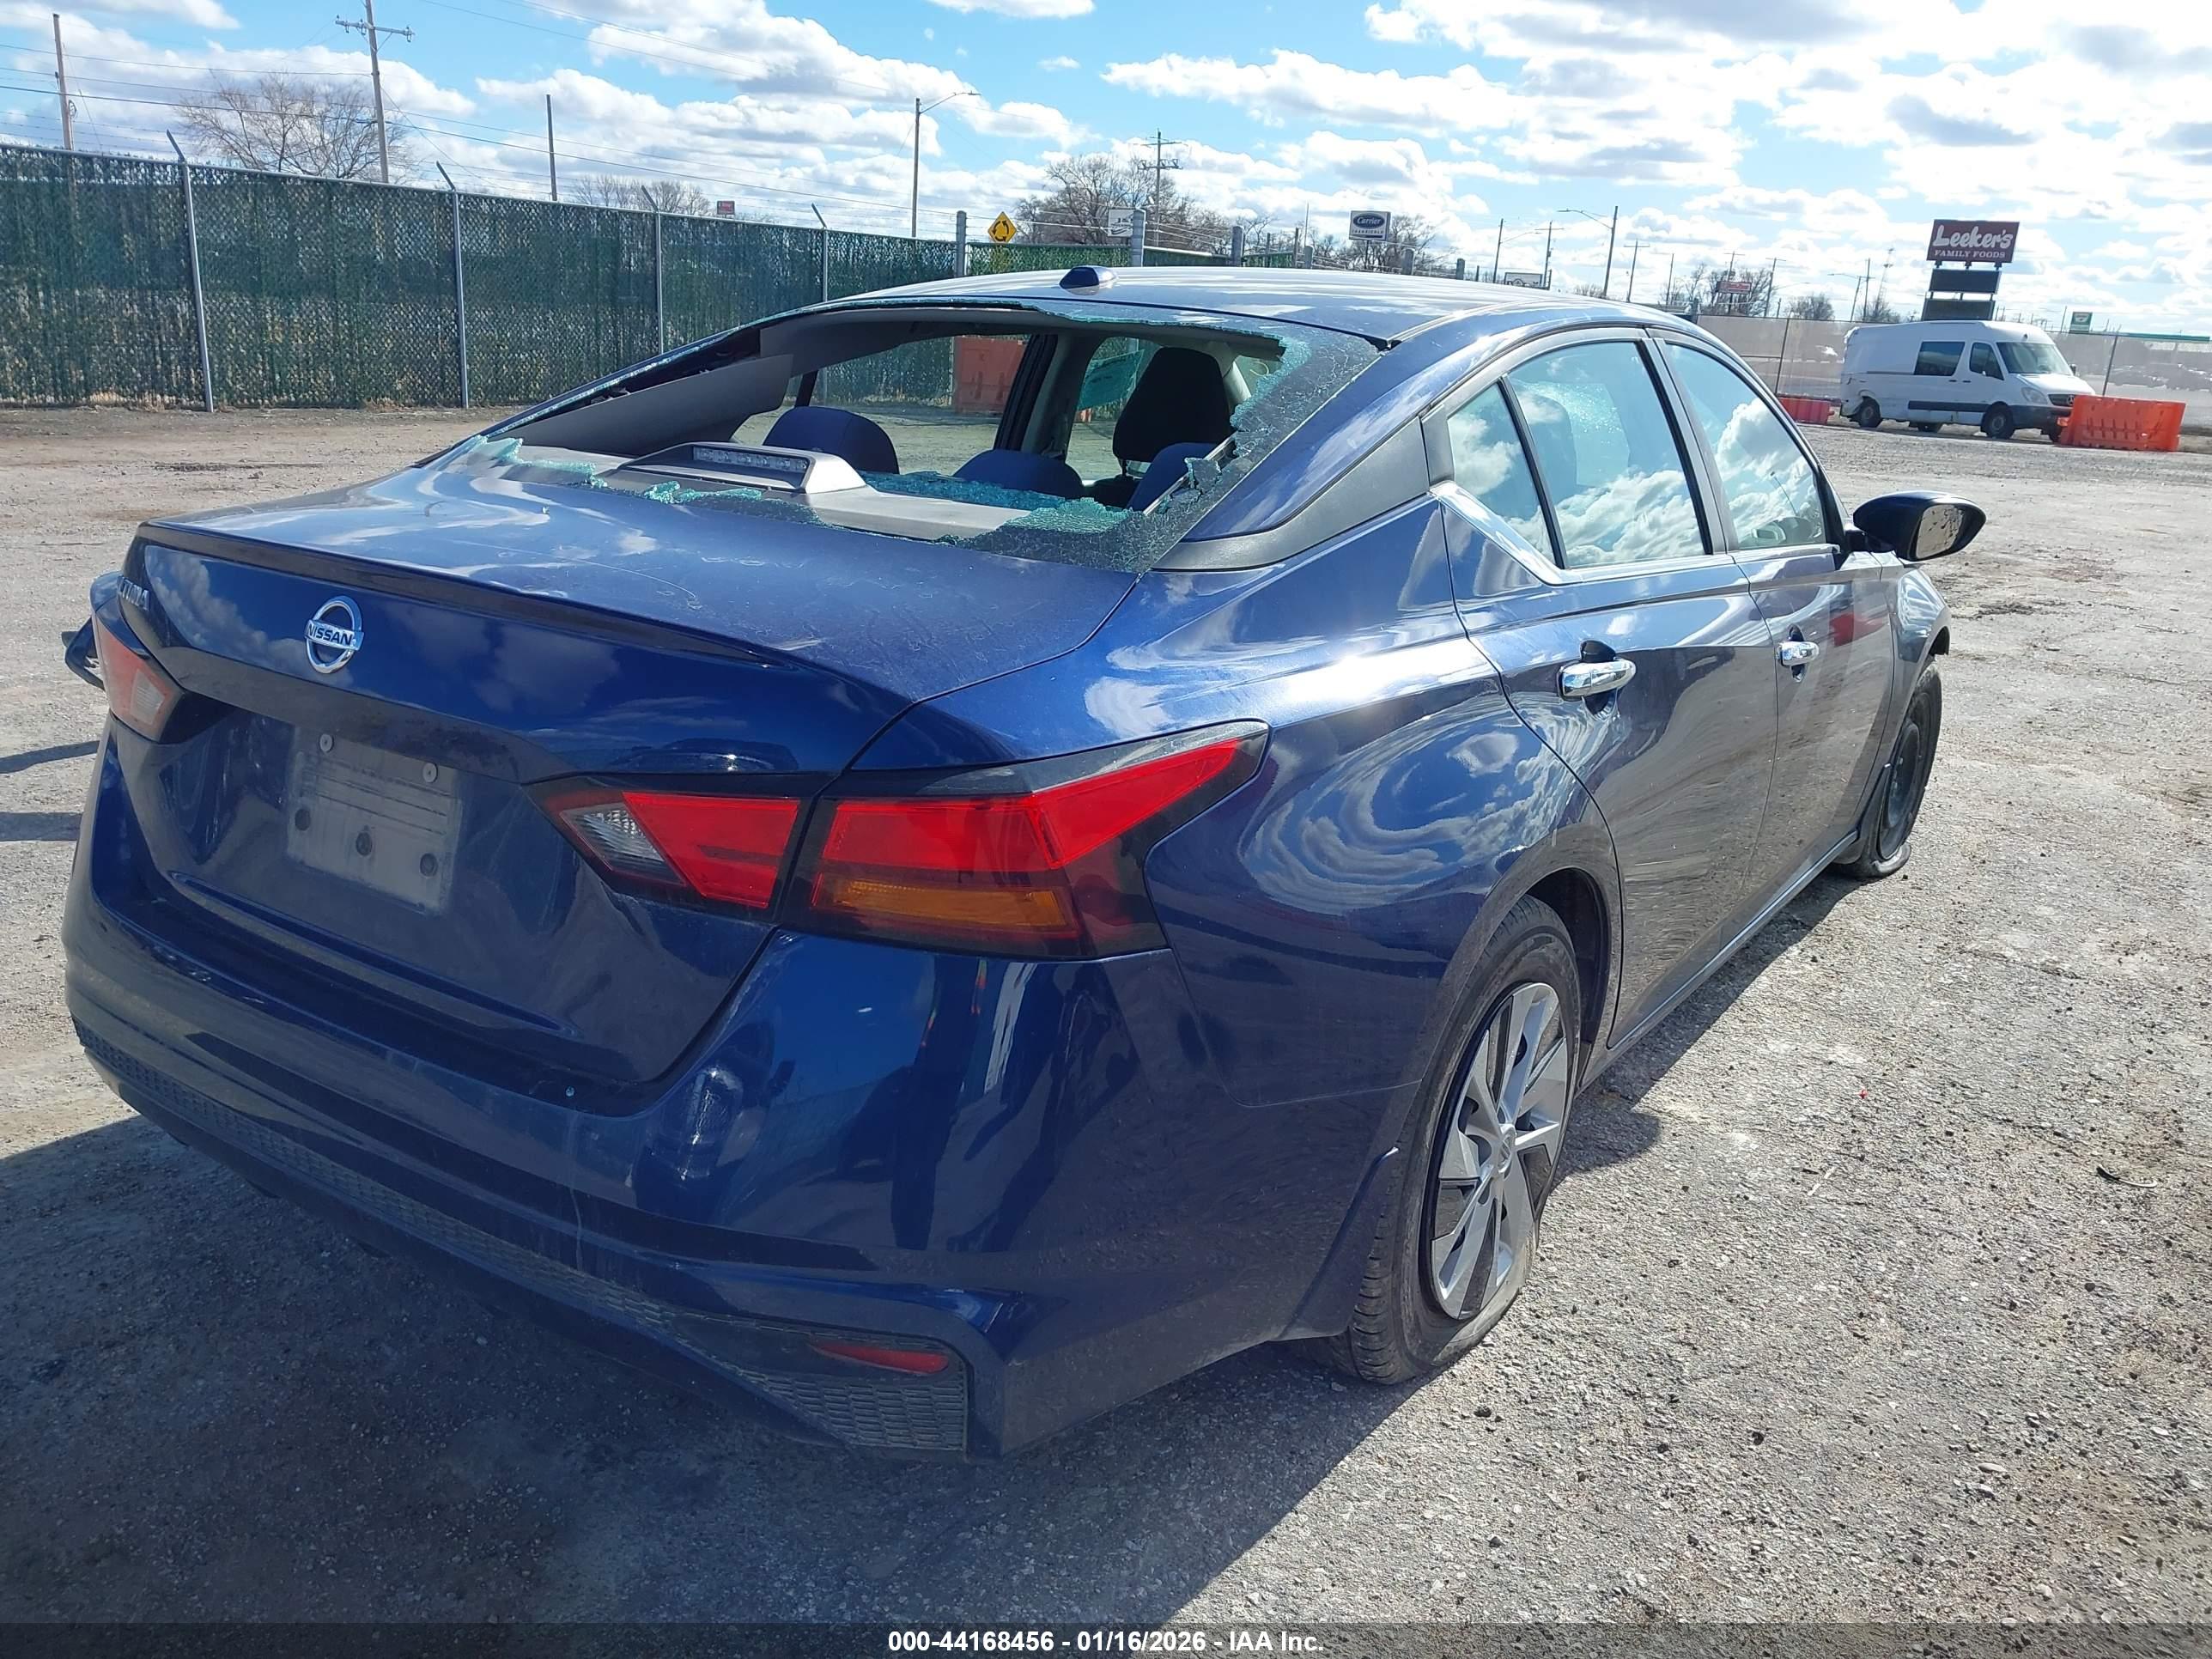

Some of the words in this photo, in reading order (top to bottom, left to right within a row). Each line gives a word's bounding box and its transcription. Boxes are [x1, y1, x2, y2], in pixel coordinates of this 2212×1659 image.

[1932, 224, 2014, 249] Leeker's
[1934, 249, 1971, 258] FAMILY
[308, 623, 353, 646] NISSAN
